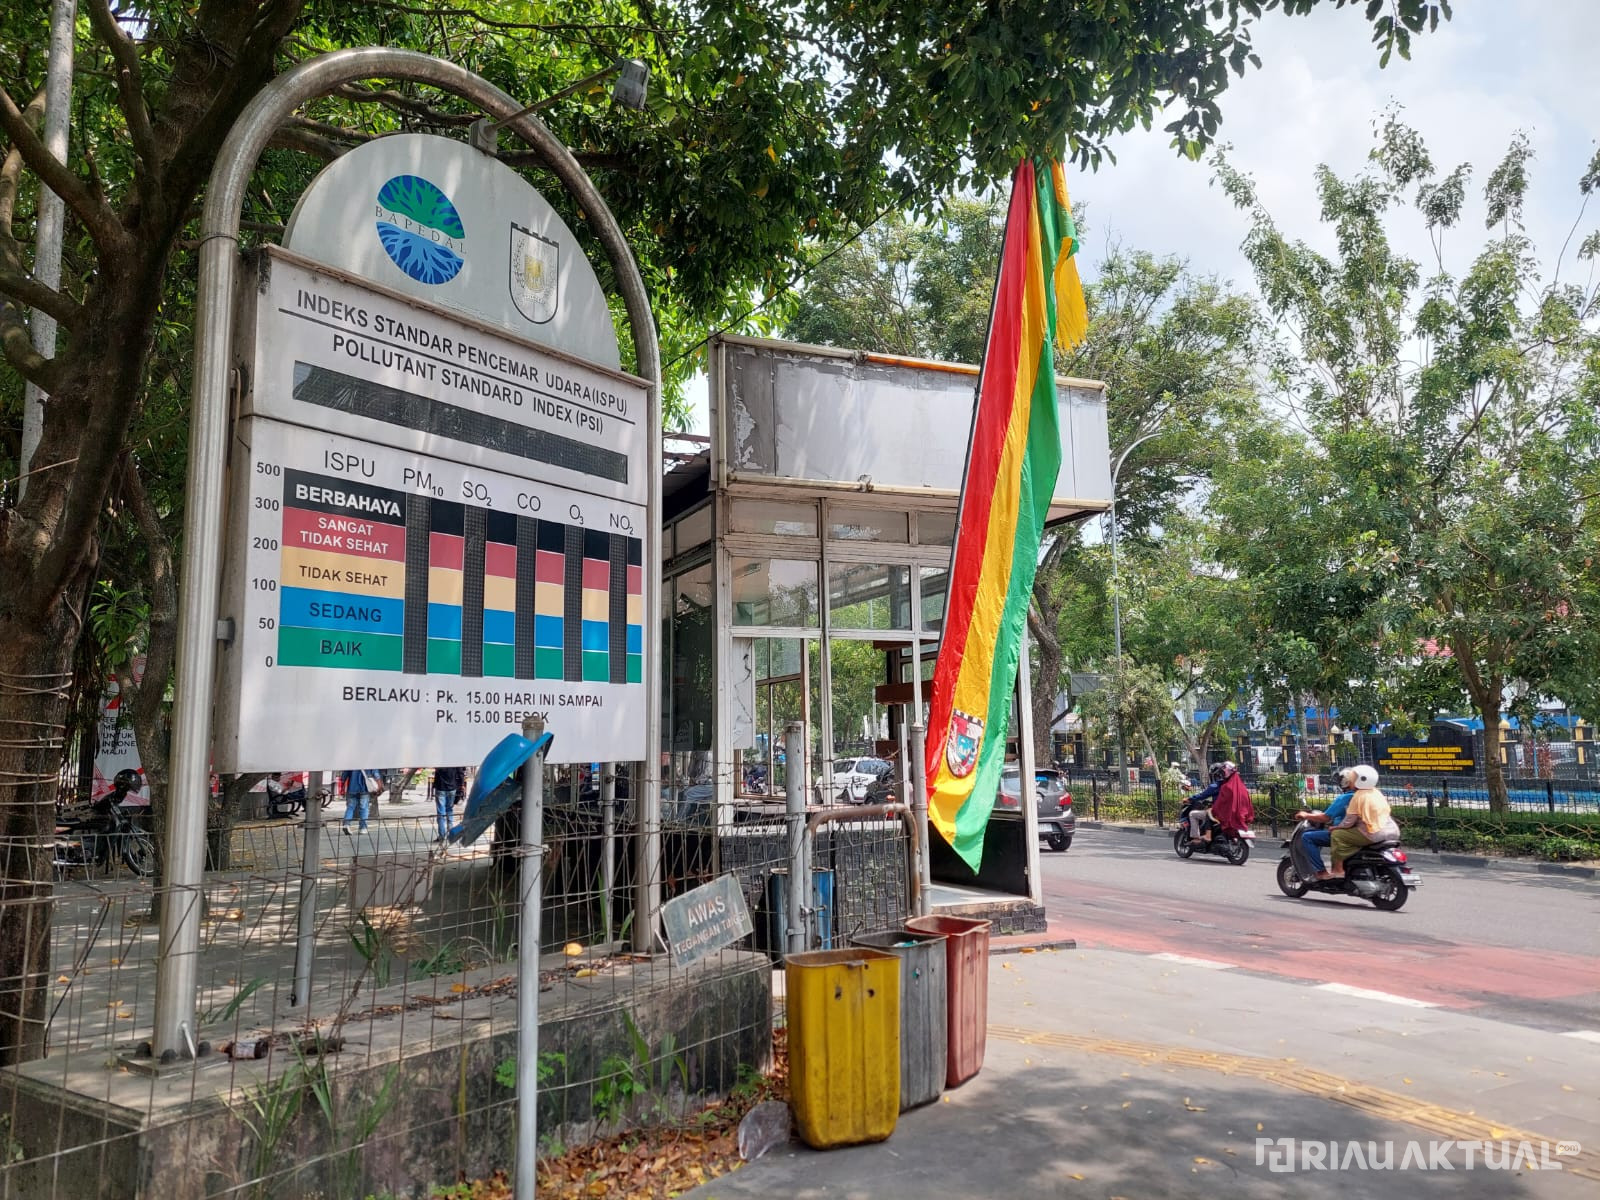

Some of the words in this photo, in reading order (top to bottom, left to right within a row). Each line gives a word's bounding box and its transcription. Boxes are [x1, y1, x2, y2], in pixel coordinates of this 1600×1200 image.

[376, 205, 467, 254] BAPEDAL
[297, 290, 368, 328] INDEKS
[374, 314, 453, 356] STANDAR
[457, 342, 539, 383] PENCEMAR
[332, 334, 436, 382] POLLUTANT
[441, 369, 523, 406] STANDARD
[533, 398, 574, 424] INDEX
[575, 408, 604, 435] (PSI)
[256, 462, 281, 477] 500
[324, 450, 376, 478] ISPU
[517, 493, 541, 512] CO
[255, 497, 280, 512] 300
[295, 484, 402, 517] BERBAHAYA
[318, 517, 374, 536] SANGAT
[253, 536, 278, 551] 200
[300, 531, 342, 549] TIDAK
[346, 538, 389, 555] SEHAT
[252, 578, 277, 592] 100
[299, 565, 341, 583] TIDAK
[345, 571, 388, 587] SEHAT
[309, 602, 382, 623] SEDANG
[258, 617, 275, 630] 50
[320, 640, 363, 657] BAIK
[265, 656, 273, 668] 0
[342, 686, 420, 703] BERLAKU
[436, 689, 458, 704] Pk.
[466, 691, 500, 705] 15.00
[504, 692, 536, 706] HARI
[539, 693, 555, 706] INI
[558, 694, 603, 708] SAMPAI
[436, 709, 458, 723] Pk.
[466, 710, 500, 724] 15.00
[688, 895, 725, 928] AWAS
[674, 923, 721, 955] TEGANGAN
